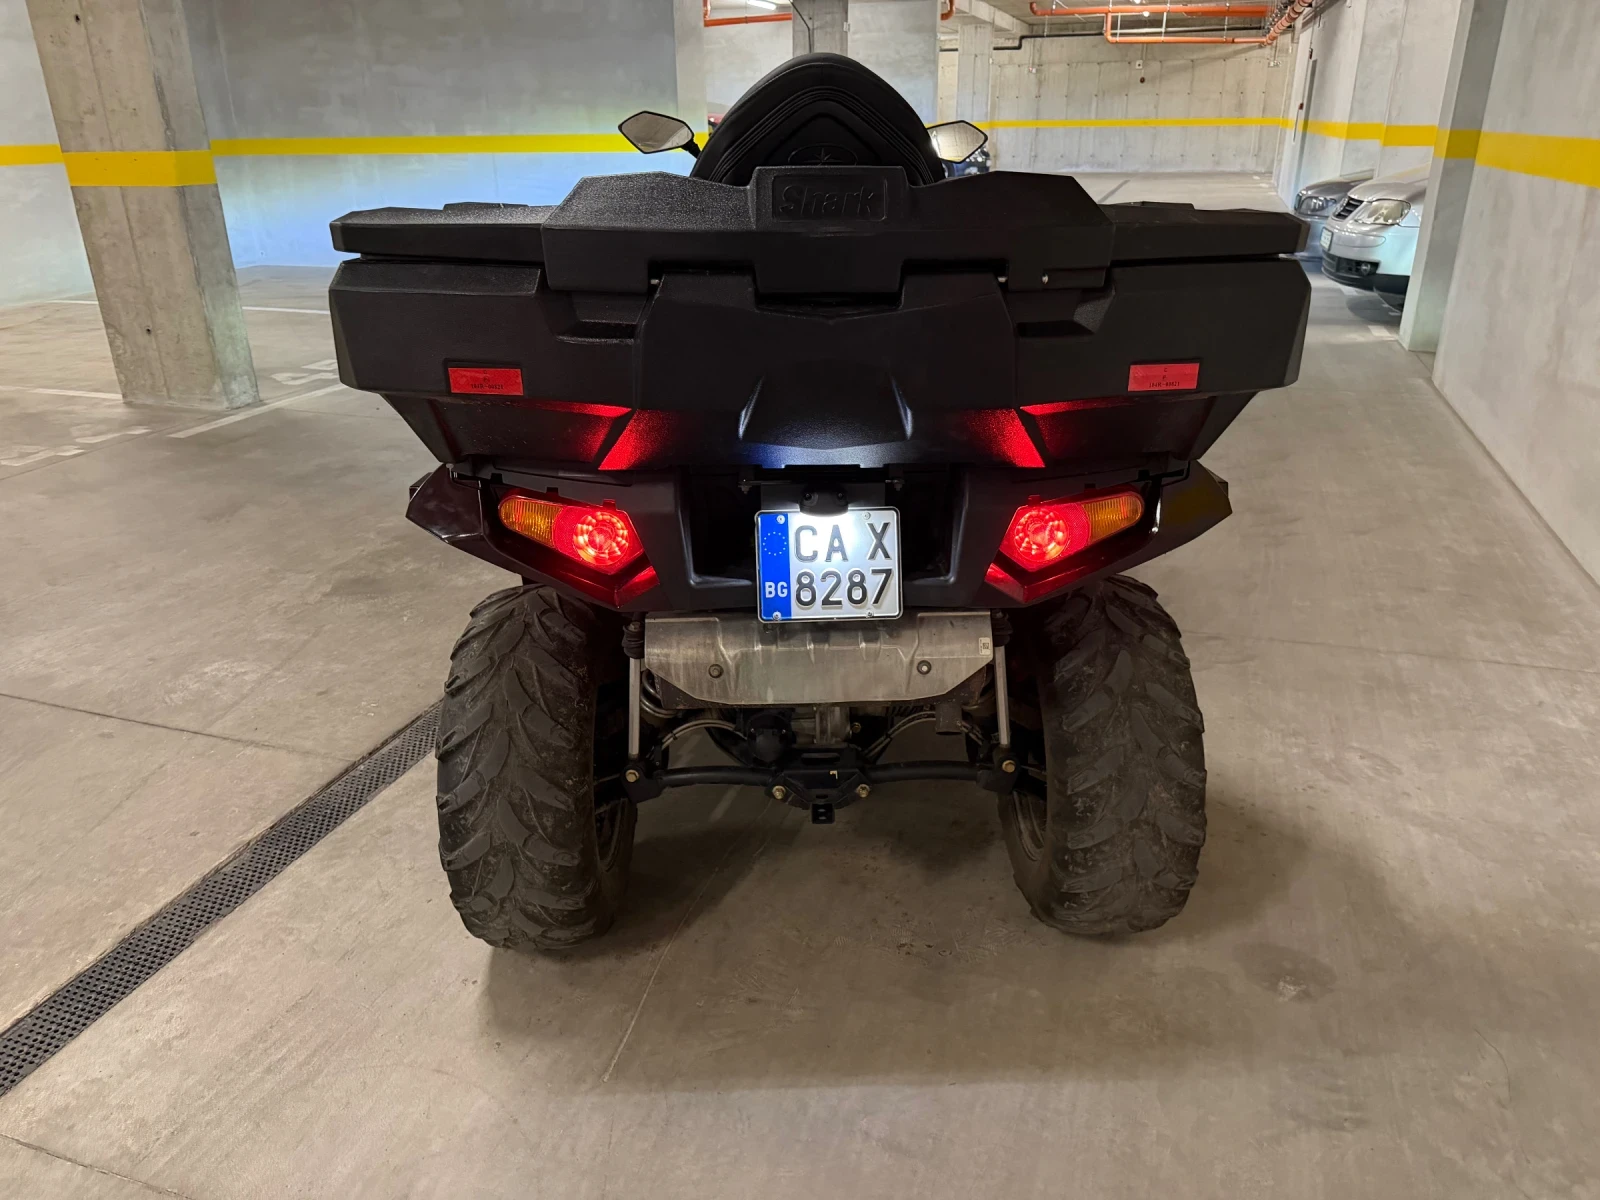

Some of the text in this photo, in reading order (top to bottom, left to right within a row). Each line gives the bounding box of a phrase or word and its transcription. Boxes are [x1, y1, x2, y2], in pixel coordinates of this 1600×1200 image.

[779, 185, 875, 214] Shark
[795, 522, 892, 562] CA X
[765, 581, 788, 598] BG
[796, 569, 892, 607] 8287
